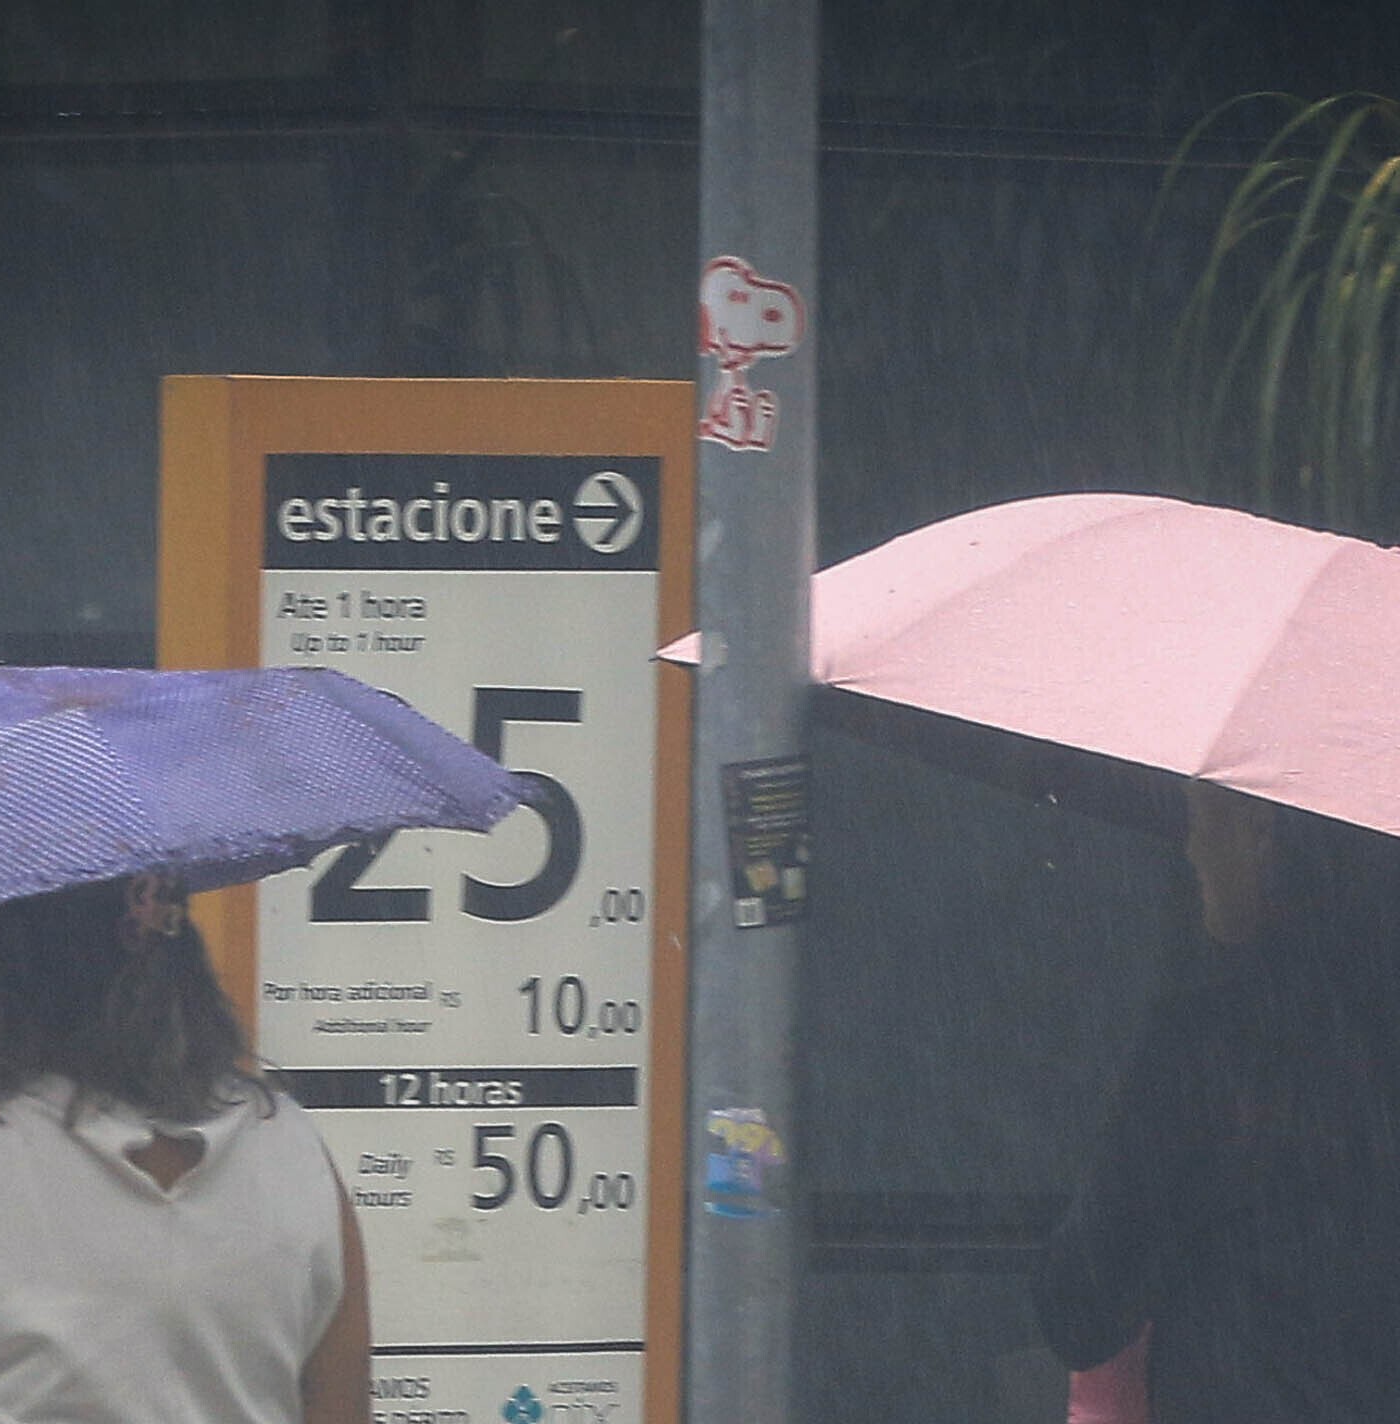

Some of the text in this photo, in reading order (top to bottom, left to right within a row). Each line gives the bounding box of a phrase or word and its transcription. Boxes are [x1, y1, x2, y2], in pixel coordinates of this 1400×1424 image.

[276, 480, 563, 544] estacione
[336, 590, 350, 618] 1
[360, 589, 427, 619] hora
[328, 632, 349, 652] to
[372, 630, 427, 652] hour
[264, 981, 295, 1001] Por
[300, 981, 342, 1002] hora
[347, 979, 434, 1001] adicional
[517, 974, 642, 1039] 10,00
[379, 1071, 523, 1105] 12 horas
[357, 1151, 413, 1180] Daily
[470, 1121, 636, 1215] 50,00
[369, 1376, 431, 1400] AMOS
